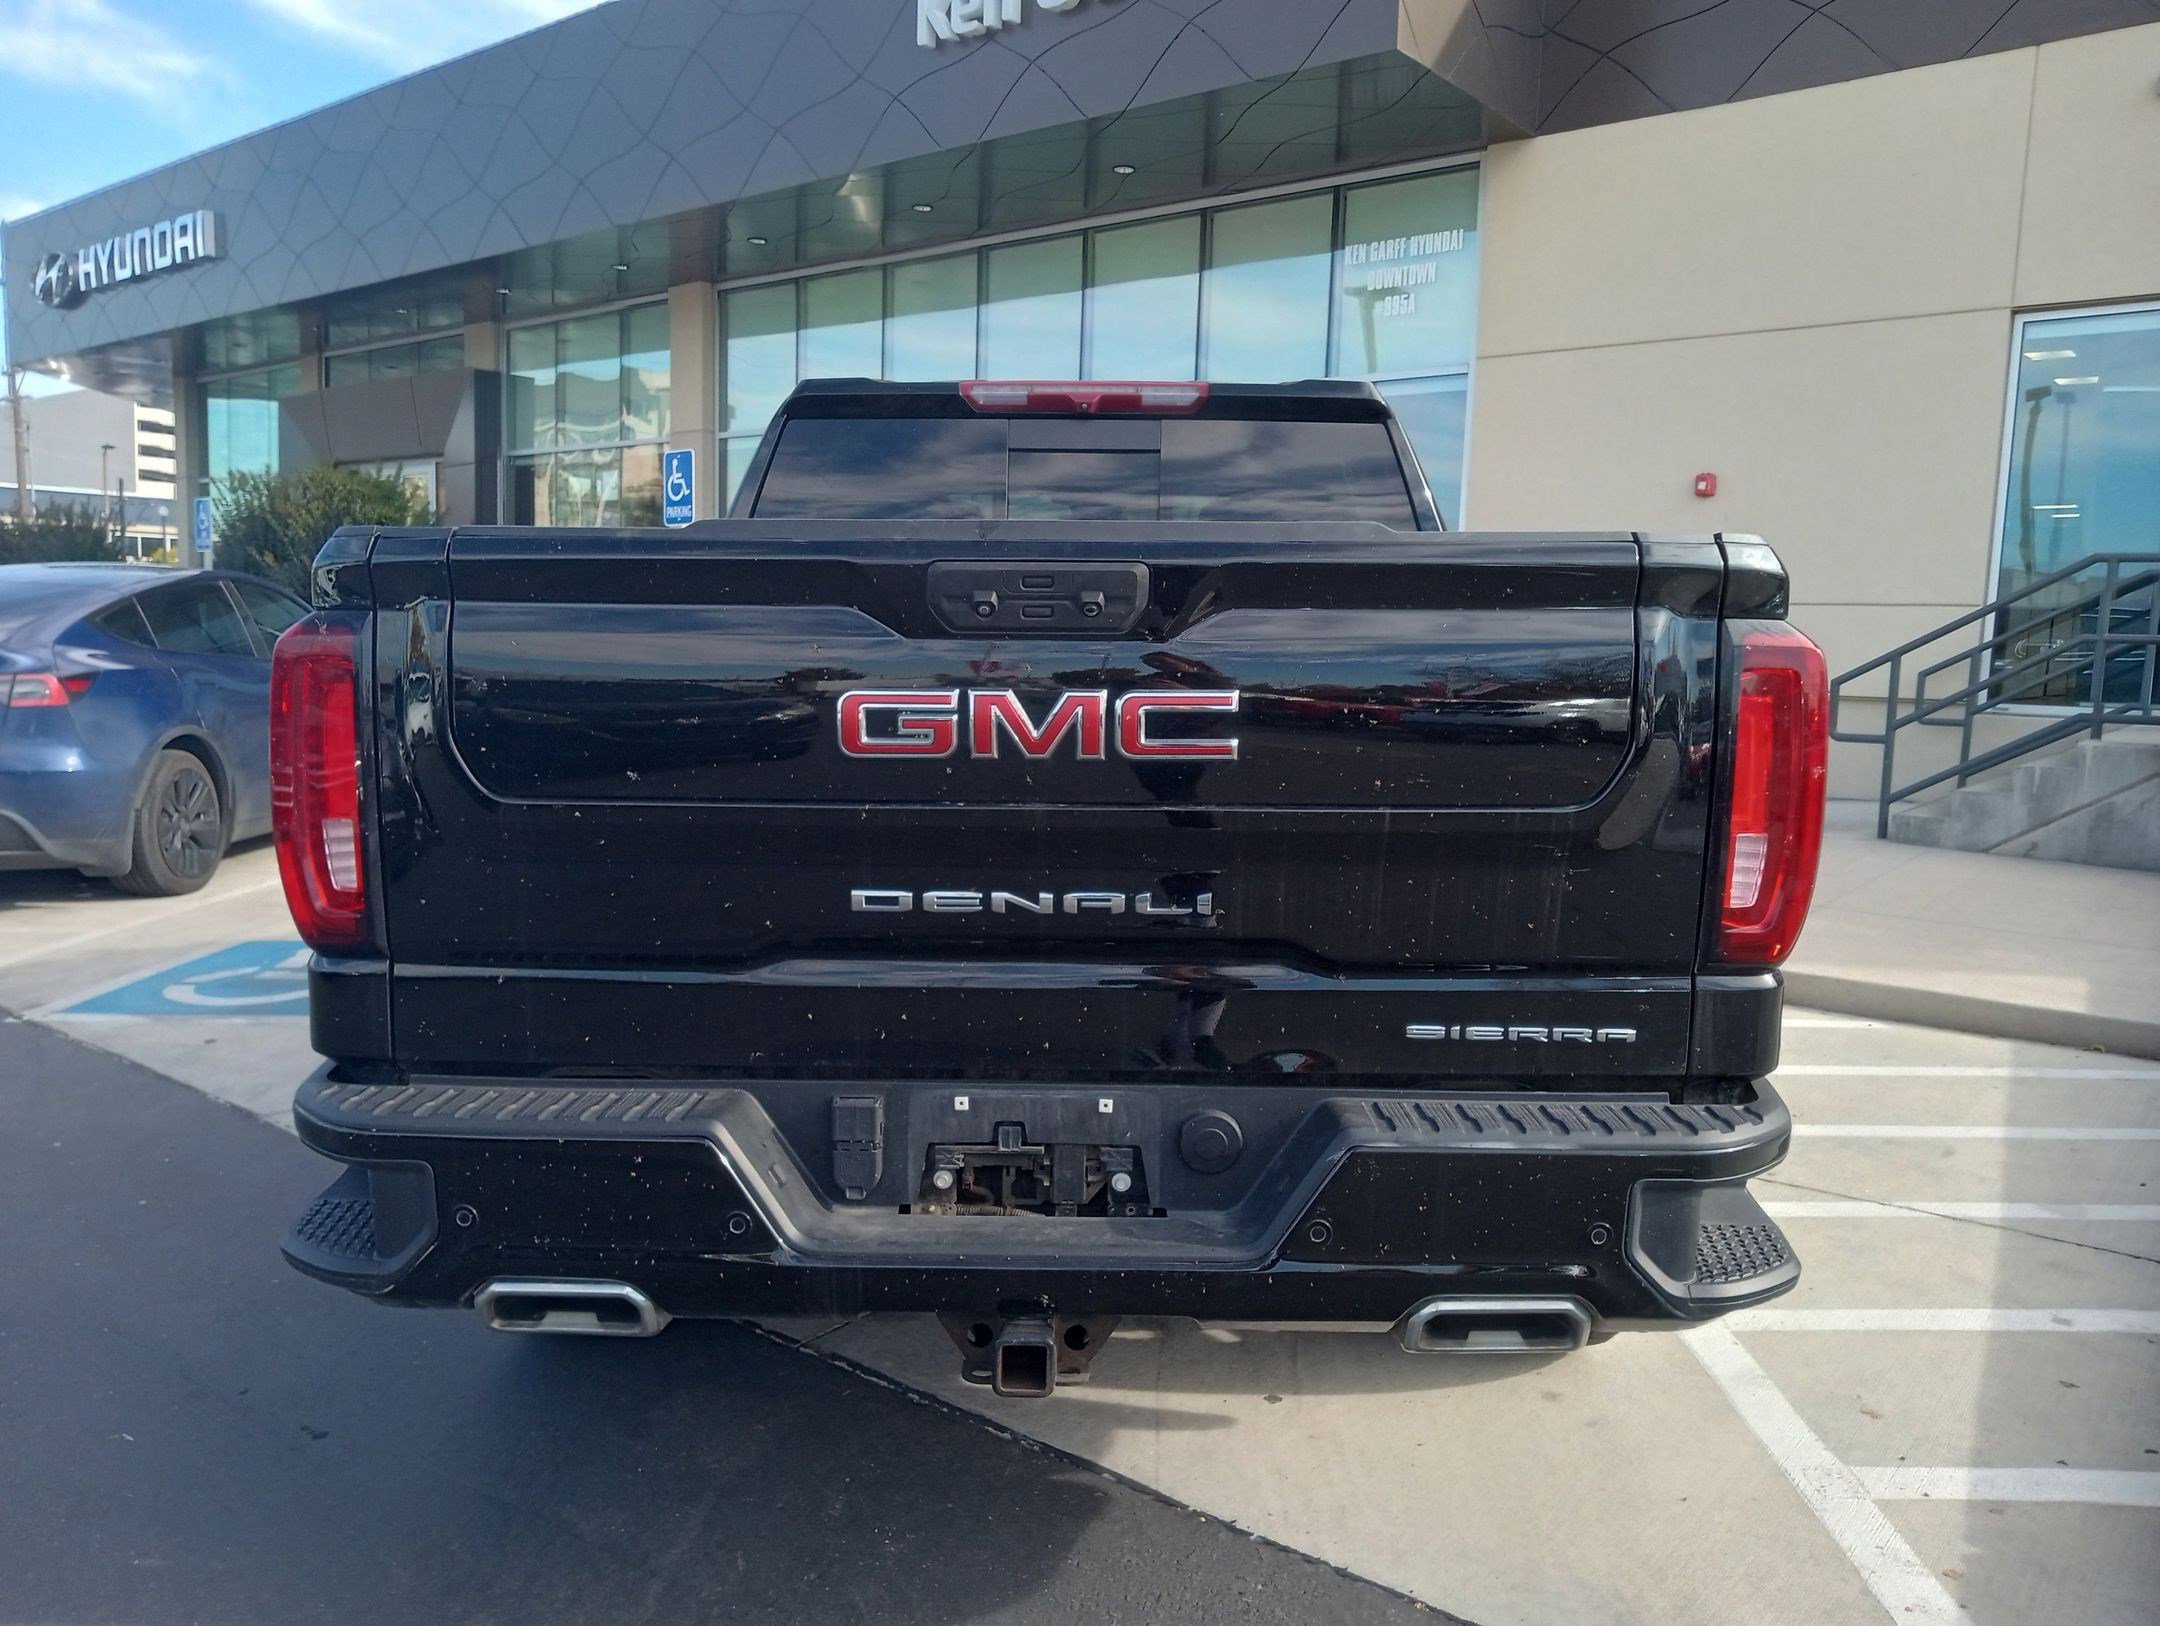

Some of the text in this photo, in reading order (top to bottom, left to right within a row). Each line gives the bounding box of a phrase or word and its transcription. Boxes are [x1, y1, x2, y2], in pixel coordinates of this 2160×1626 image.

[78, 210, 215, 292] HYUNDAI
[1345, 229, 1464, 265] KEN GARFF HYUNDAI
[1367, 262, 1436, 291] DOWNTOWN
[666, 505, 692, 518] PARKING
[837, 689, 1240, 761] GMC
[851, 889, 1213, 915] DENALI
[1405, 1025, 1637, 1043] SIERRA
